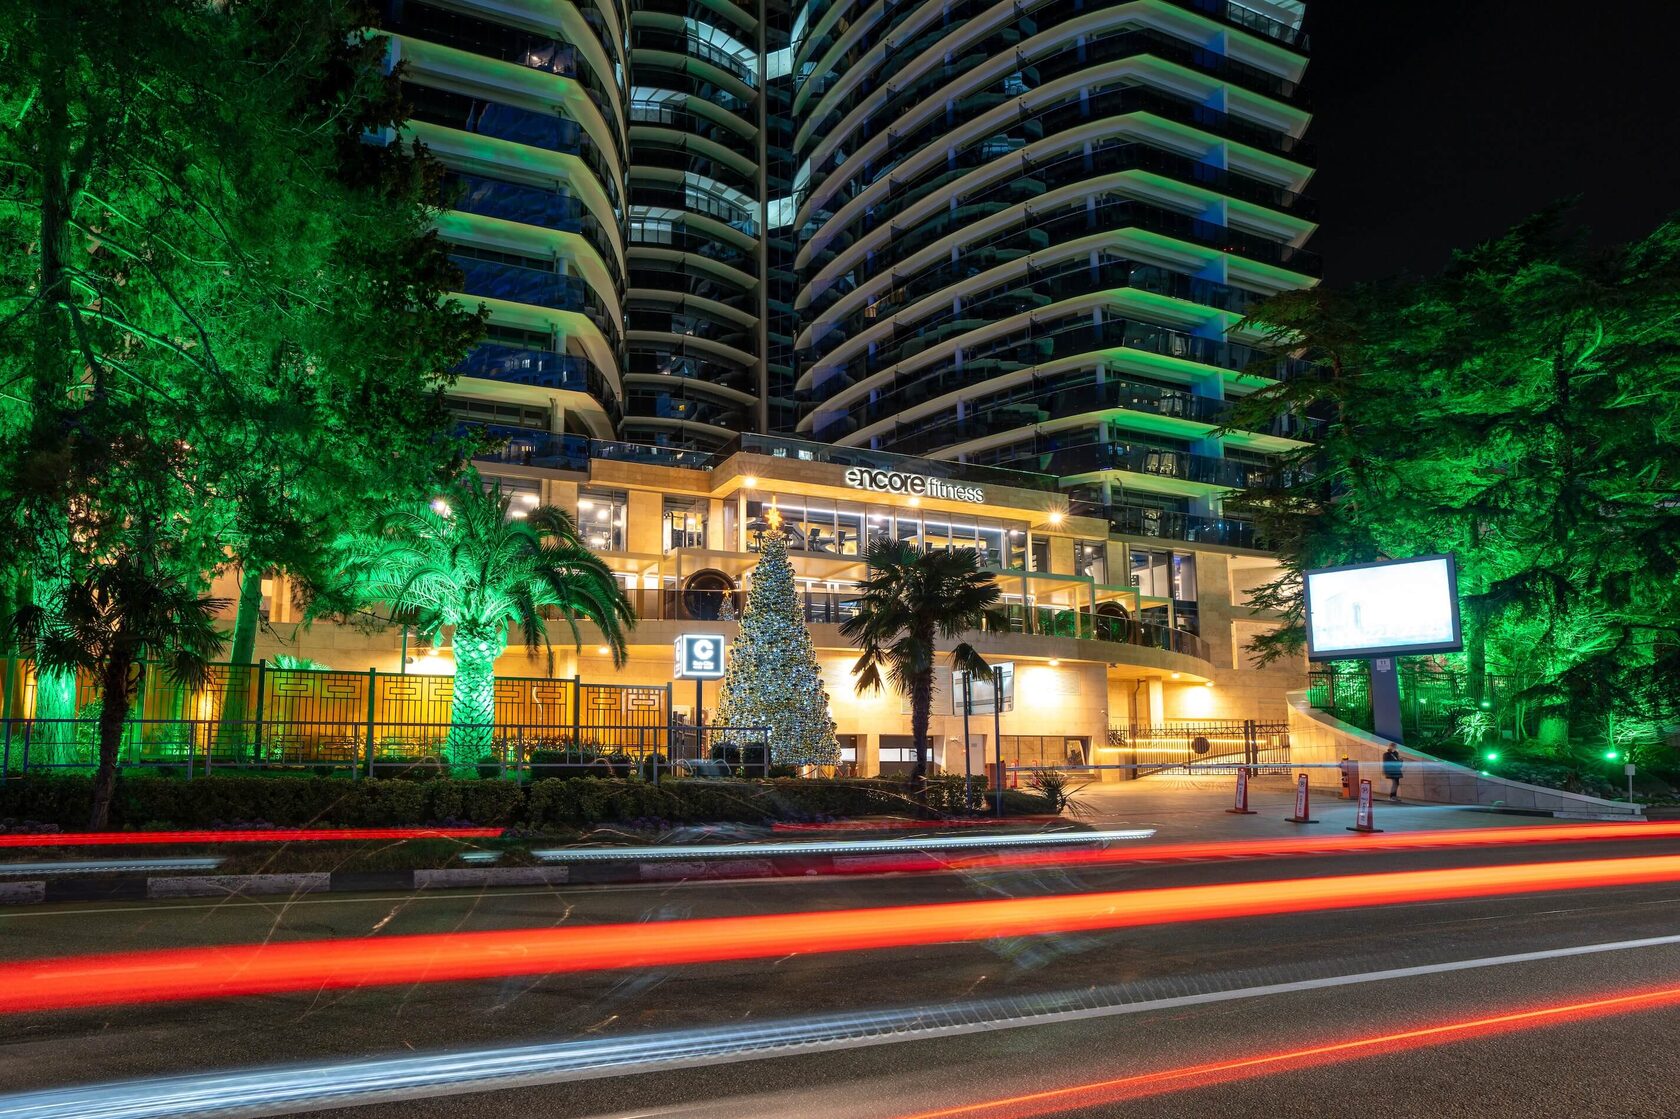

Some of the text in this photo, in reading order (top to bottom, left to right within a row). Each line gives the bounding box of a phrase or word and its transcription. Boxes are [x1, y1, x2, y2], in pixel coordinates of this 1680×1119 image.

[847, 468, 984, 502] encore fitness
[693, 639, 714, 660] C
